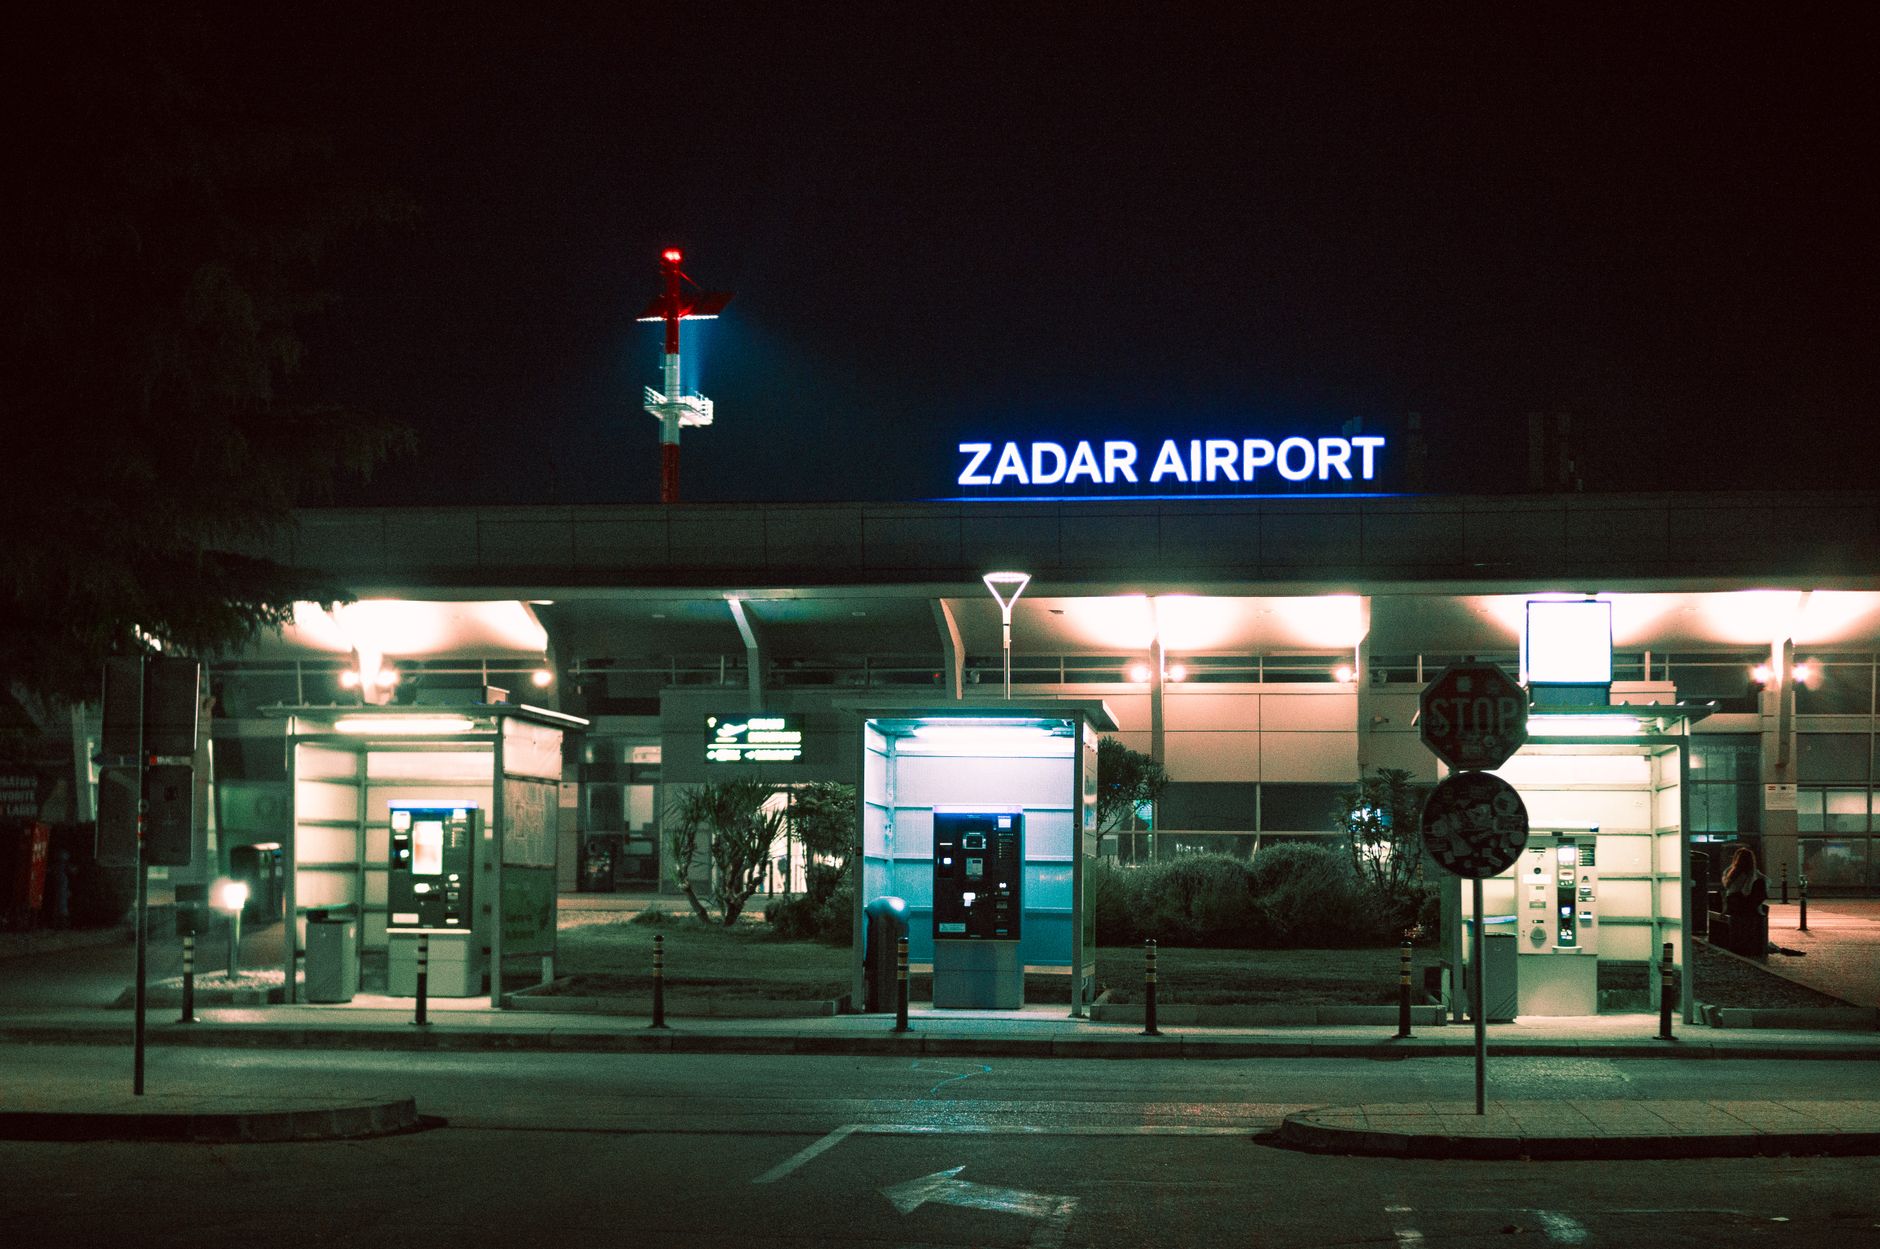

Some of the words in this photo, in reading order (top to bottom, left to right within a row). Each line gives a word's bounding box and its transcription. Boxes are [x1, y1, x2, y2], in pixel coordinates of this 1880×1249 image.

[957, 441, 1138, 485] ZADAR
[1149, 437, 1386, 482] AIRPORT
[1428, 696, 1519, 737] STOP
